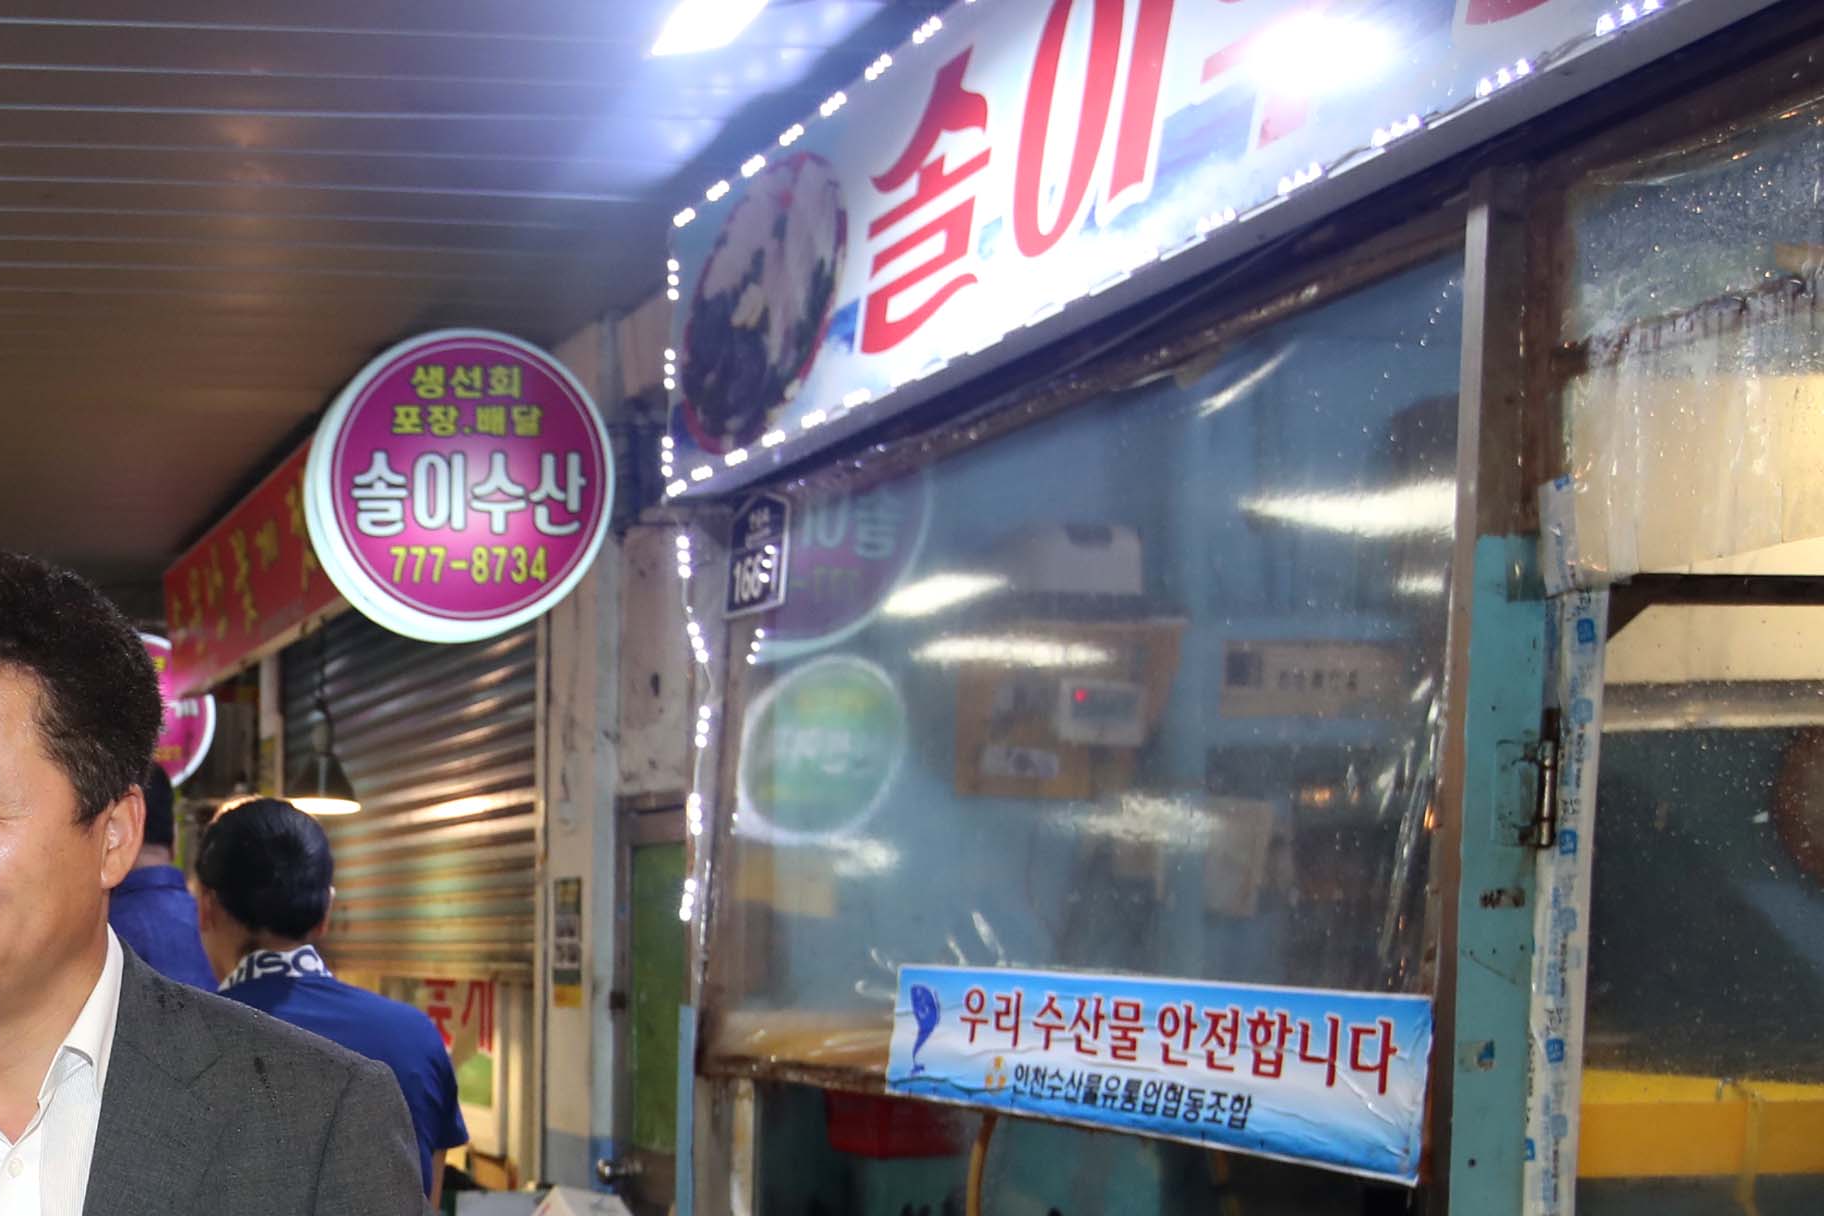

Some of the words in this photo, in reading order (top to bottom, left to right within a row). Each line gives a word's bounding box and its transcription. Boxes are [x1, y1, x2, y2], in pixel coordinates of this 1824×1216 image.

[411, 364, 523, 400] 생선회
[350, 450, 587, 538] 솔이수산
[389, 545, 548, 584] 777-8734
[959, 986, 1023, 1049] 우리
[1032, 994, 1145, 1062] 수산물
[1157, 1003, 1398, 1096] 안전합니다
